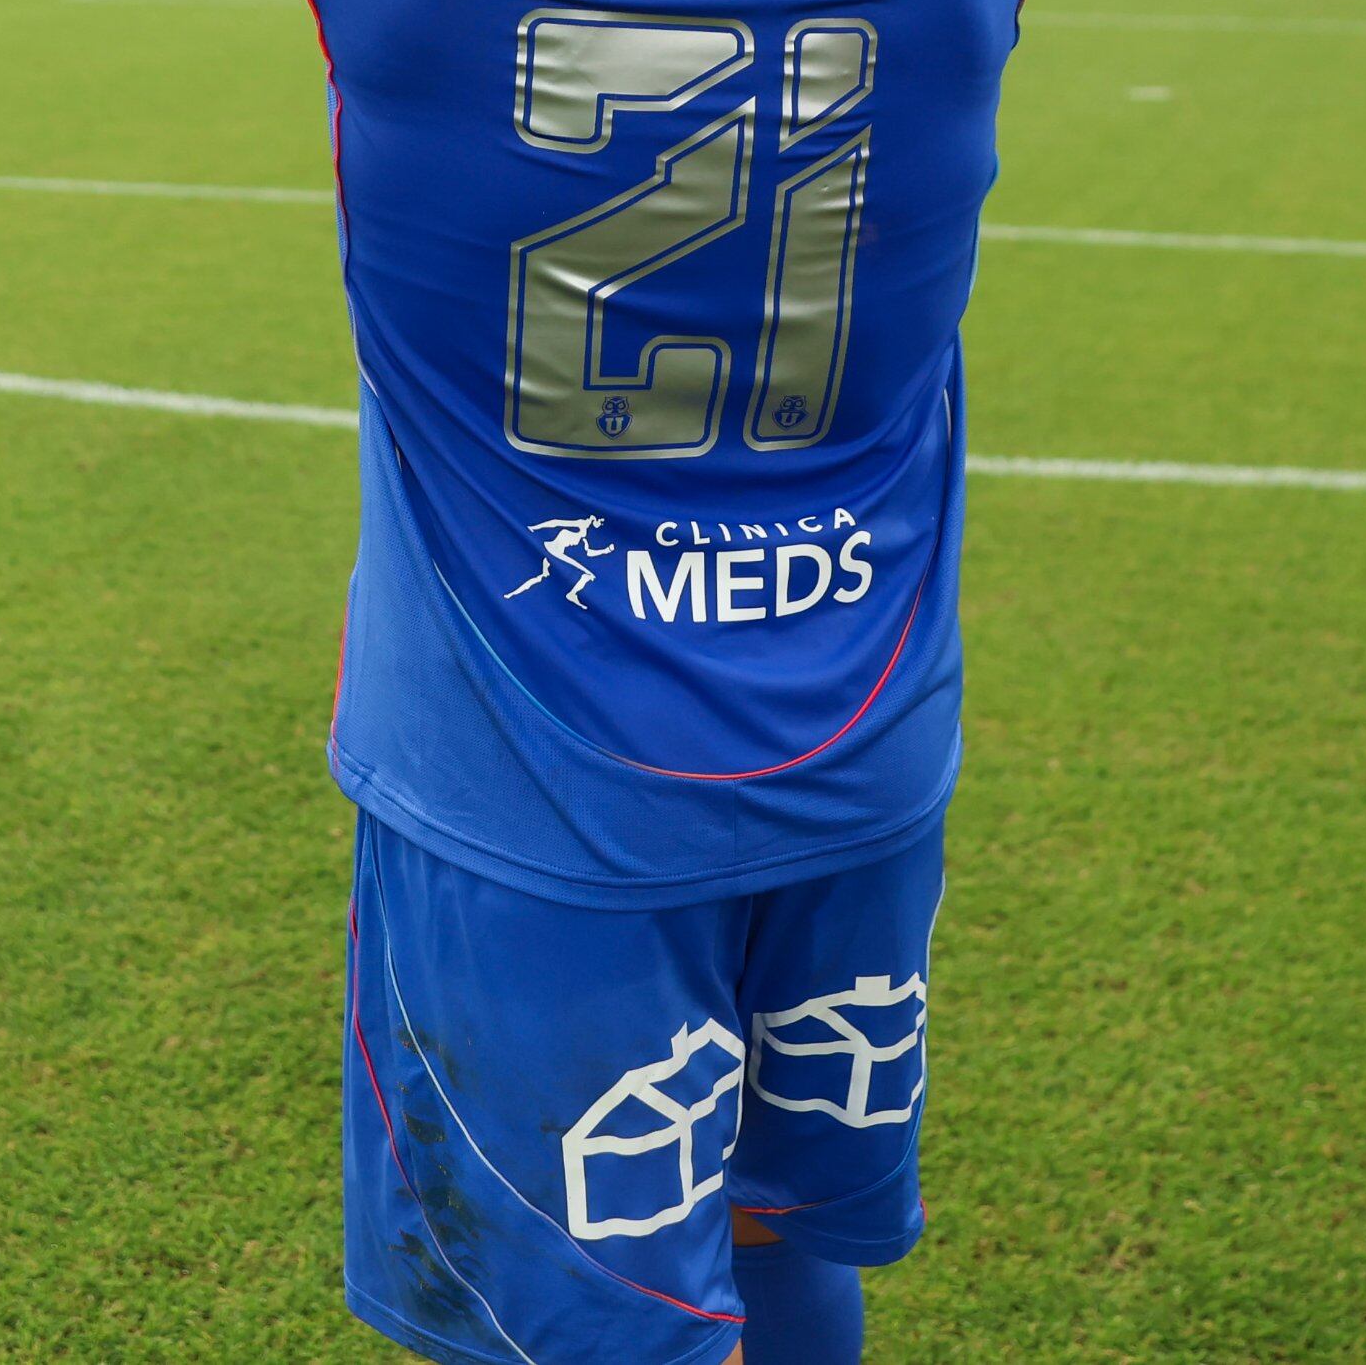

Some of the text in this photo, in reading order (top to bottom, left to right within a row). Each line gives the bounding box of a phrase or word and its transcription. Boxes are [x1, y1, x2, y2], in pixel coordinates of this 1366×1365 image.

[503, 7, 878, 460] 21
[655, 507, 857, 547] CLINICA
[626, 530, 873, 623] MEDS
